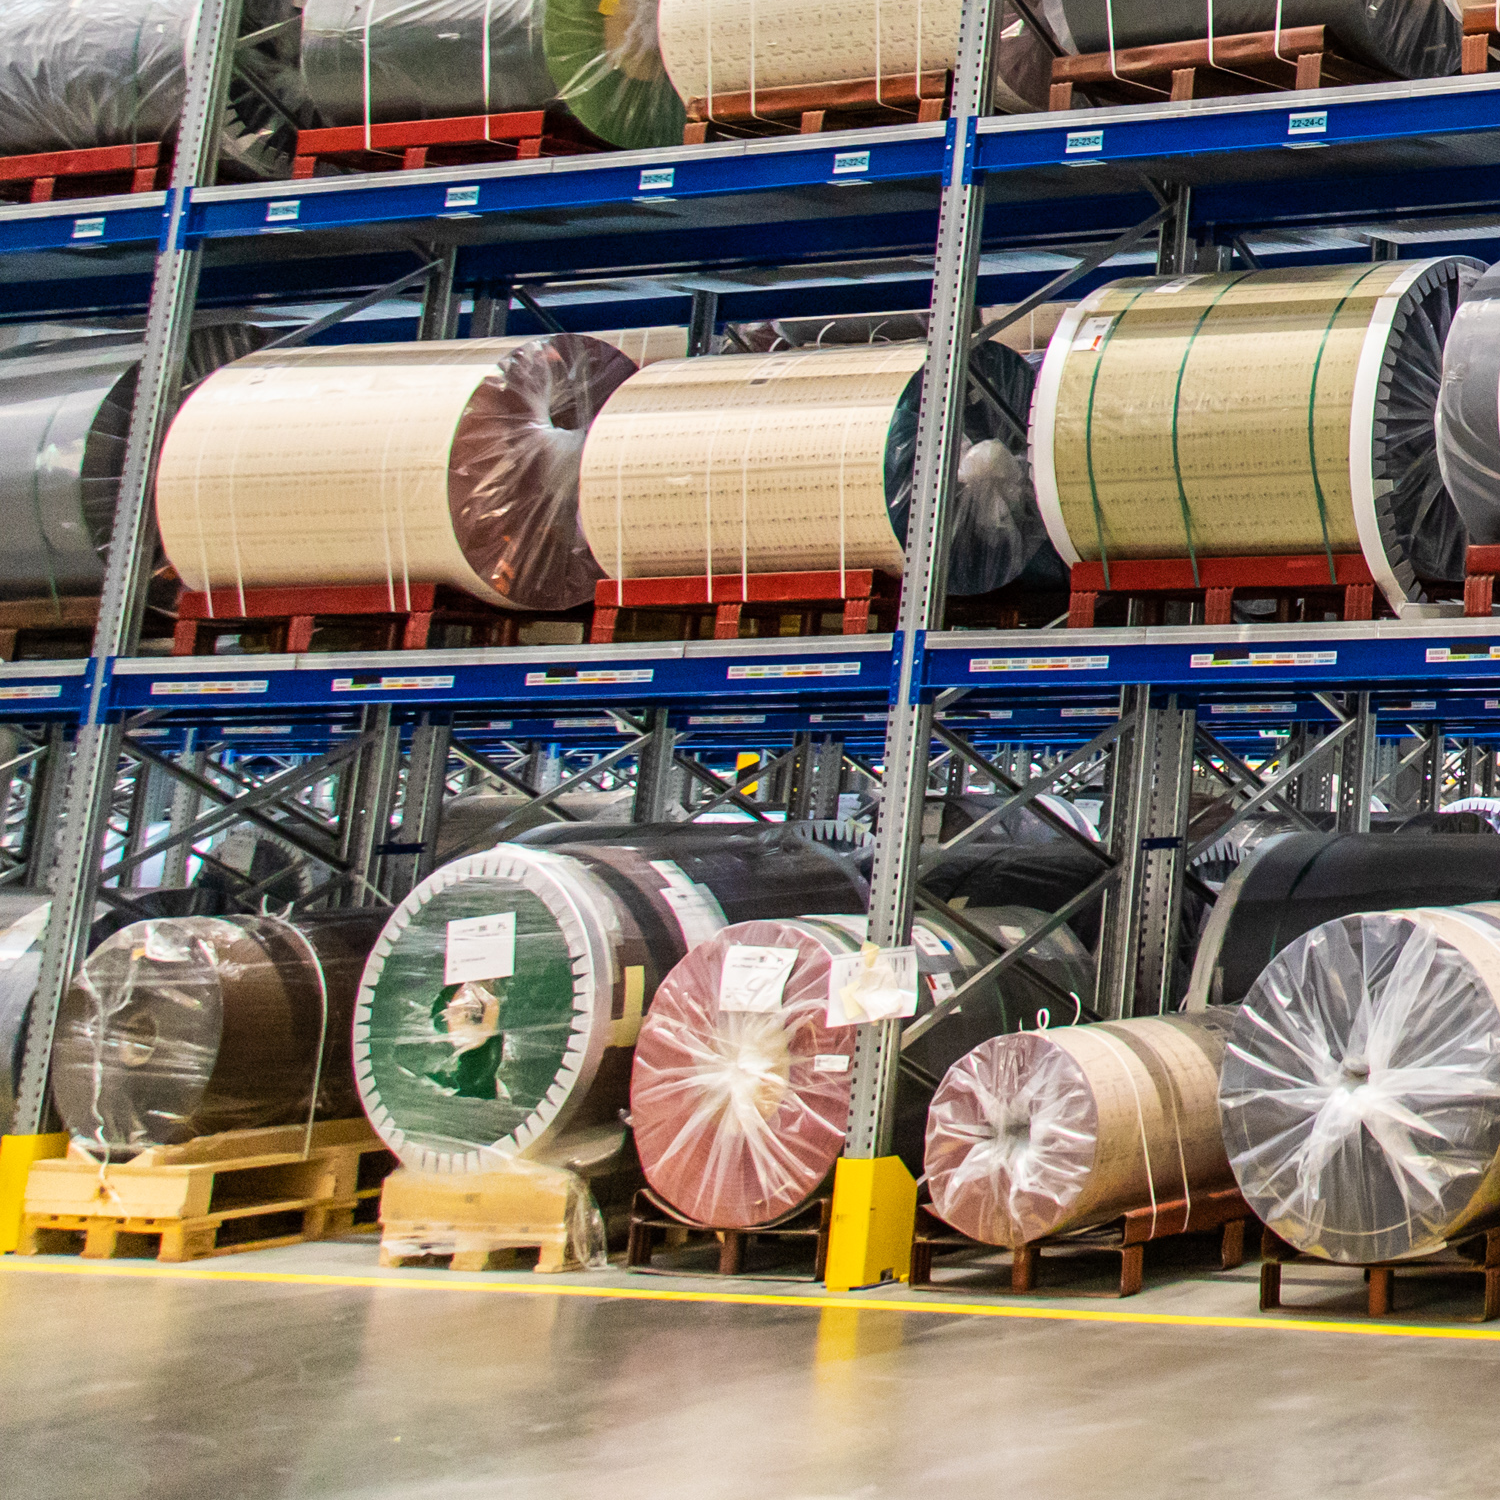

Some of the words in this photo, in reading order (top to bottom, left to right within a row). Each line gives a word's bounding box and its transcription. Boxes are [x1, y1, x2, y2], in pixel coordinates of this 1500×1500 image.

[1291, 117, 1325, 128] 22-24-C
[1069, 136, 1101, 147] 22-23-C
[837, 156, 866, 167] 22-22-C
